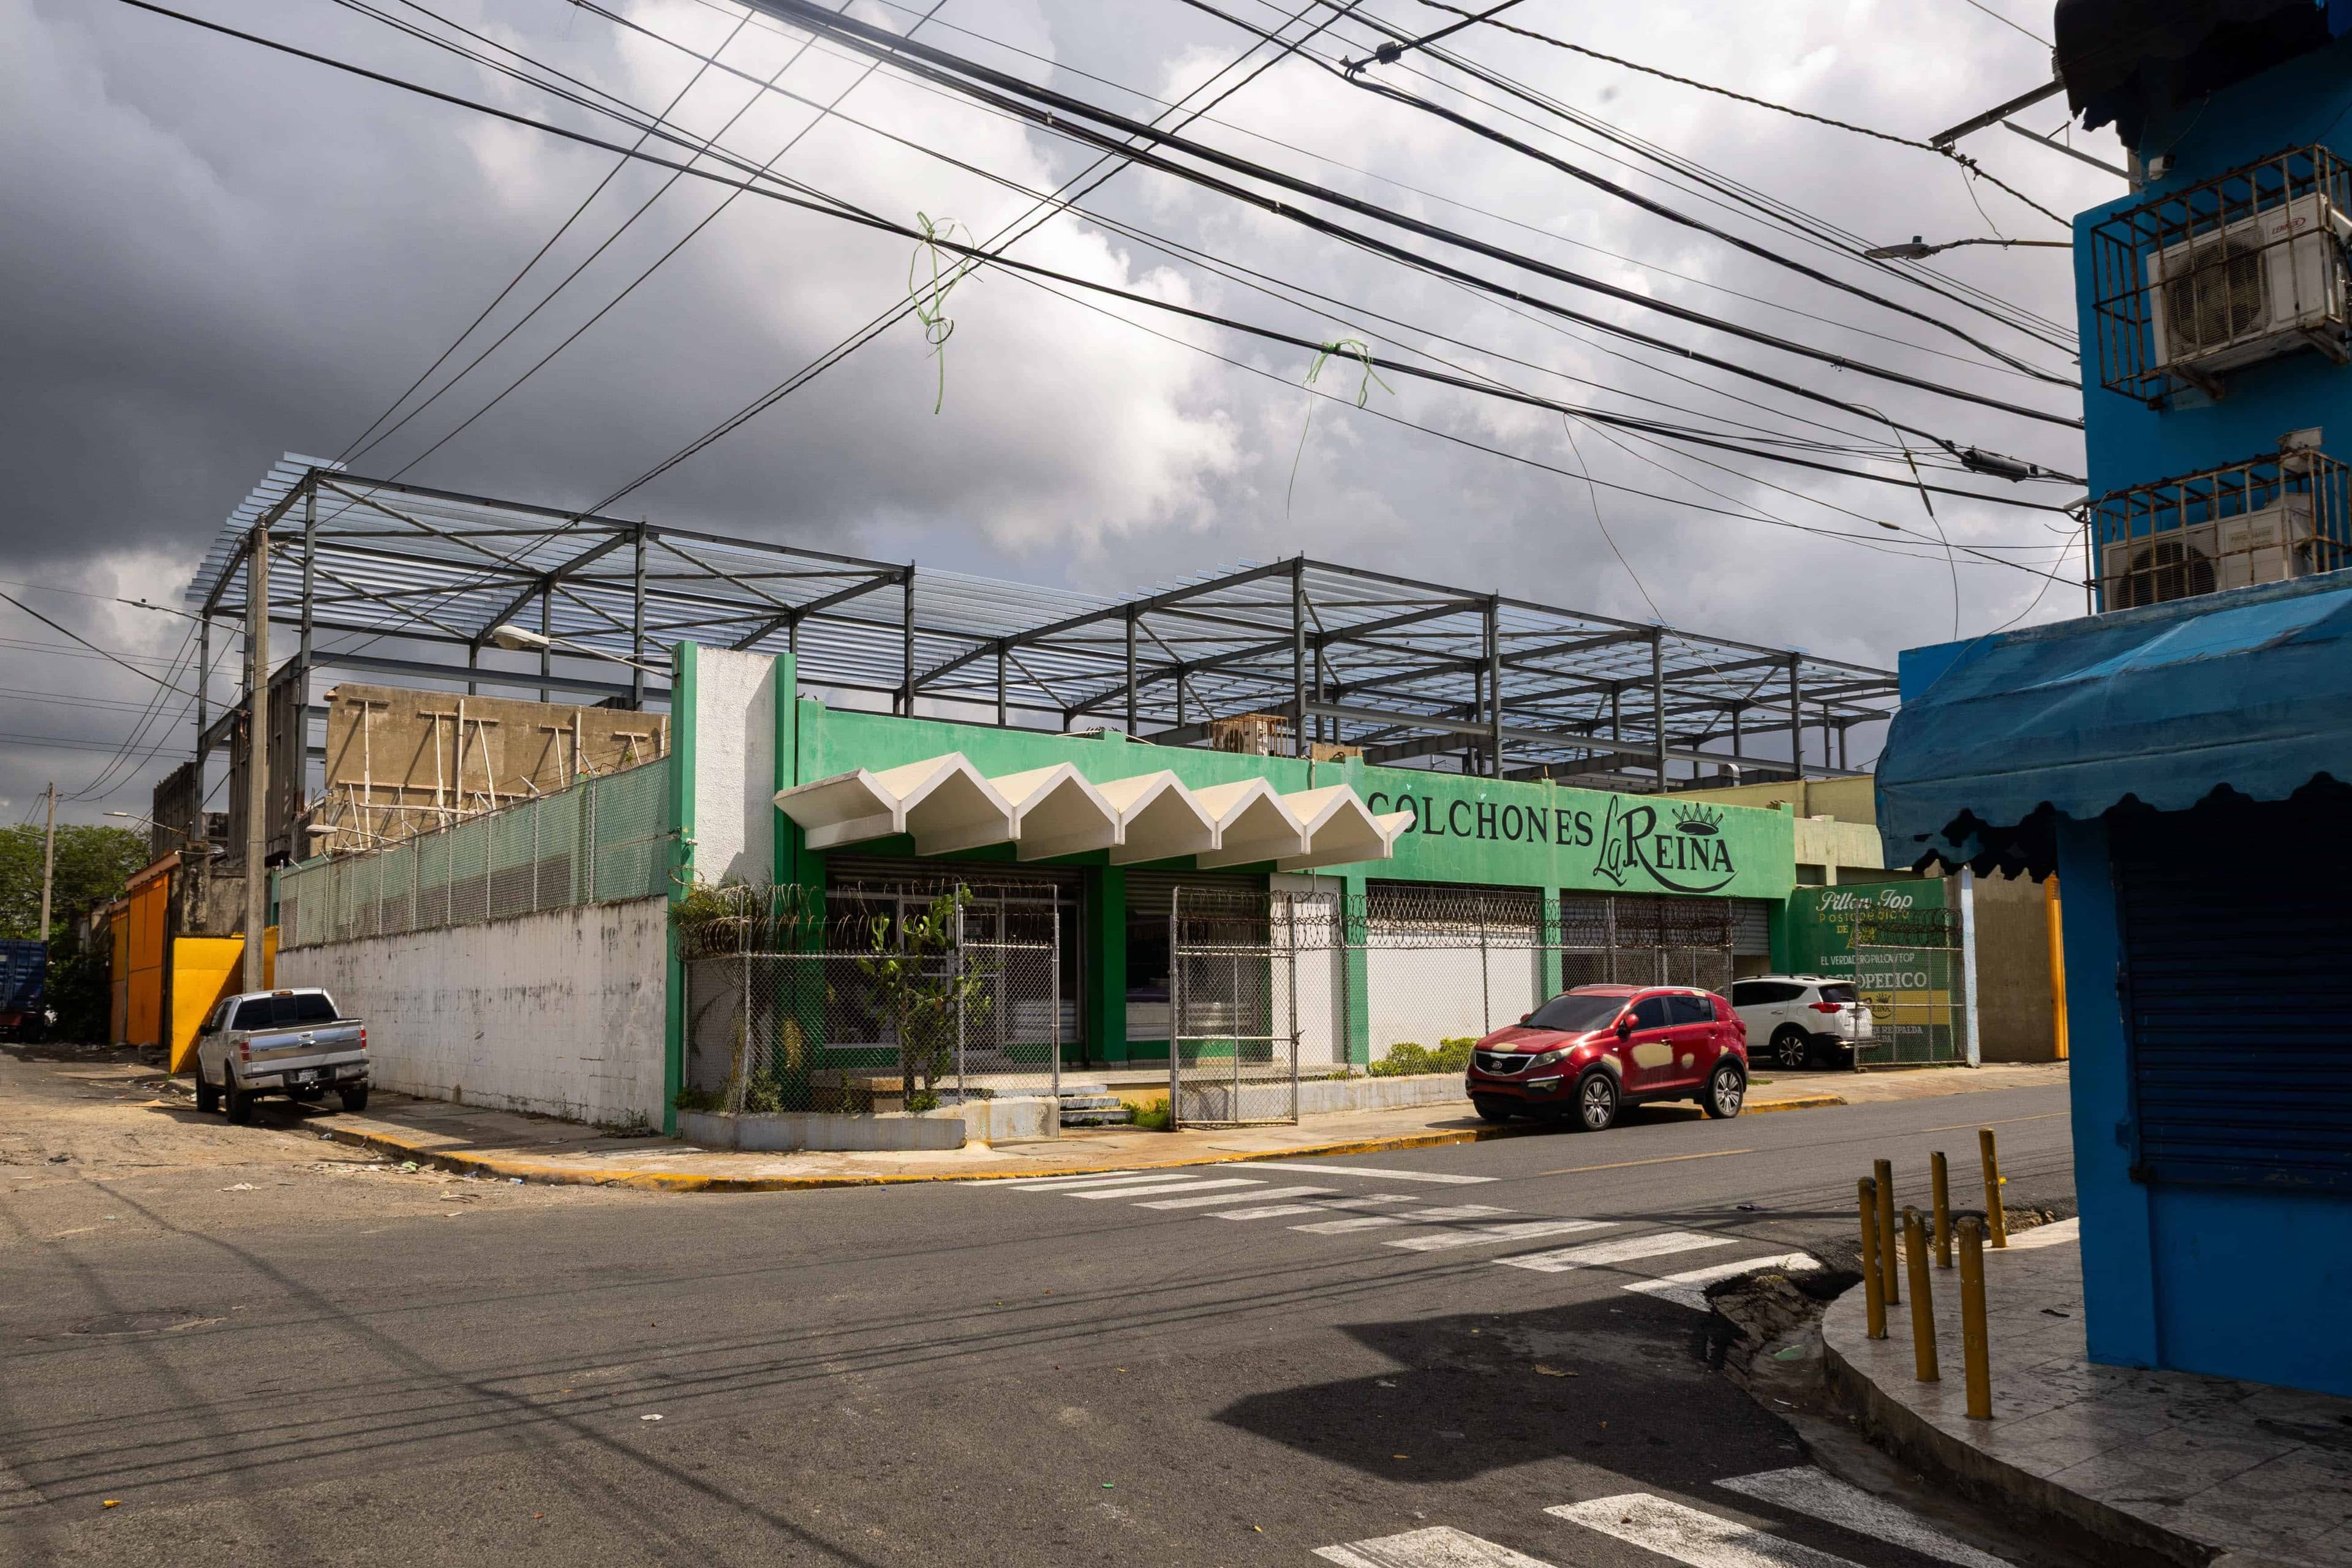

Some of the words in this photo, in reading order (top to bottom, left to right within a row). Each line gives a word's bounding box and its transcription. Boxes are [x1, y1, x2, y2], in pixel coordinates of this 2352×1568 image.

[1368, 791, 1594, 847] COLCHONES
[1593, 794, 1627, 888] La
[1617, 804, 1740, 894] REINA
[1877, 889, 1913, 912] Top
[1836, 925, 1849, 934] DE
[1820, 956, 1830, 966] EL
[1831, 952, 1871, 965] VERDADRO
[1898, 952, 1915, 962] TOP
